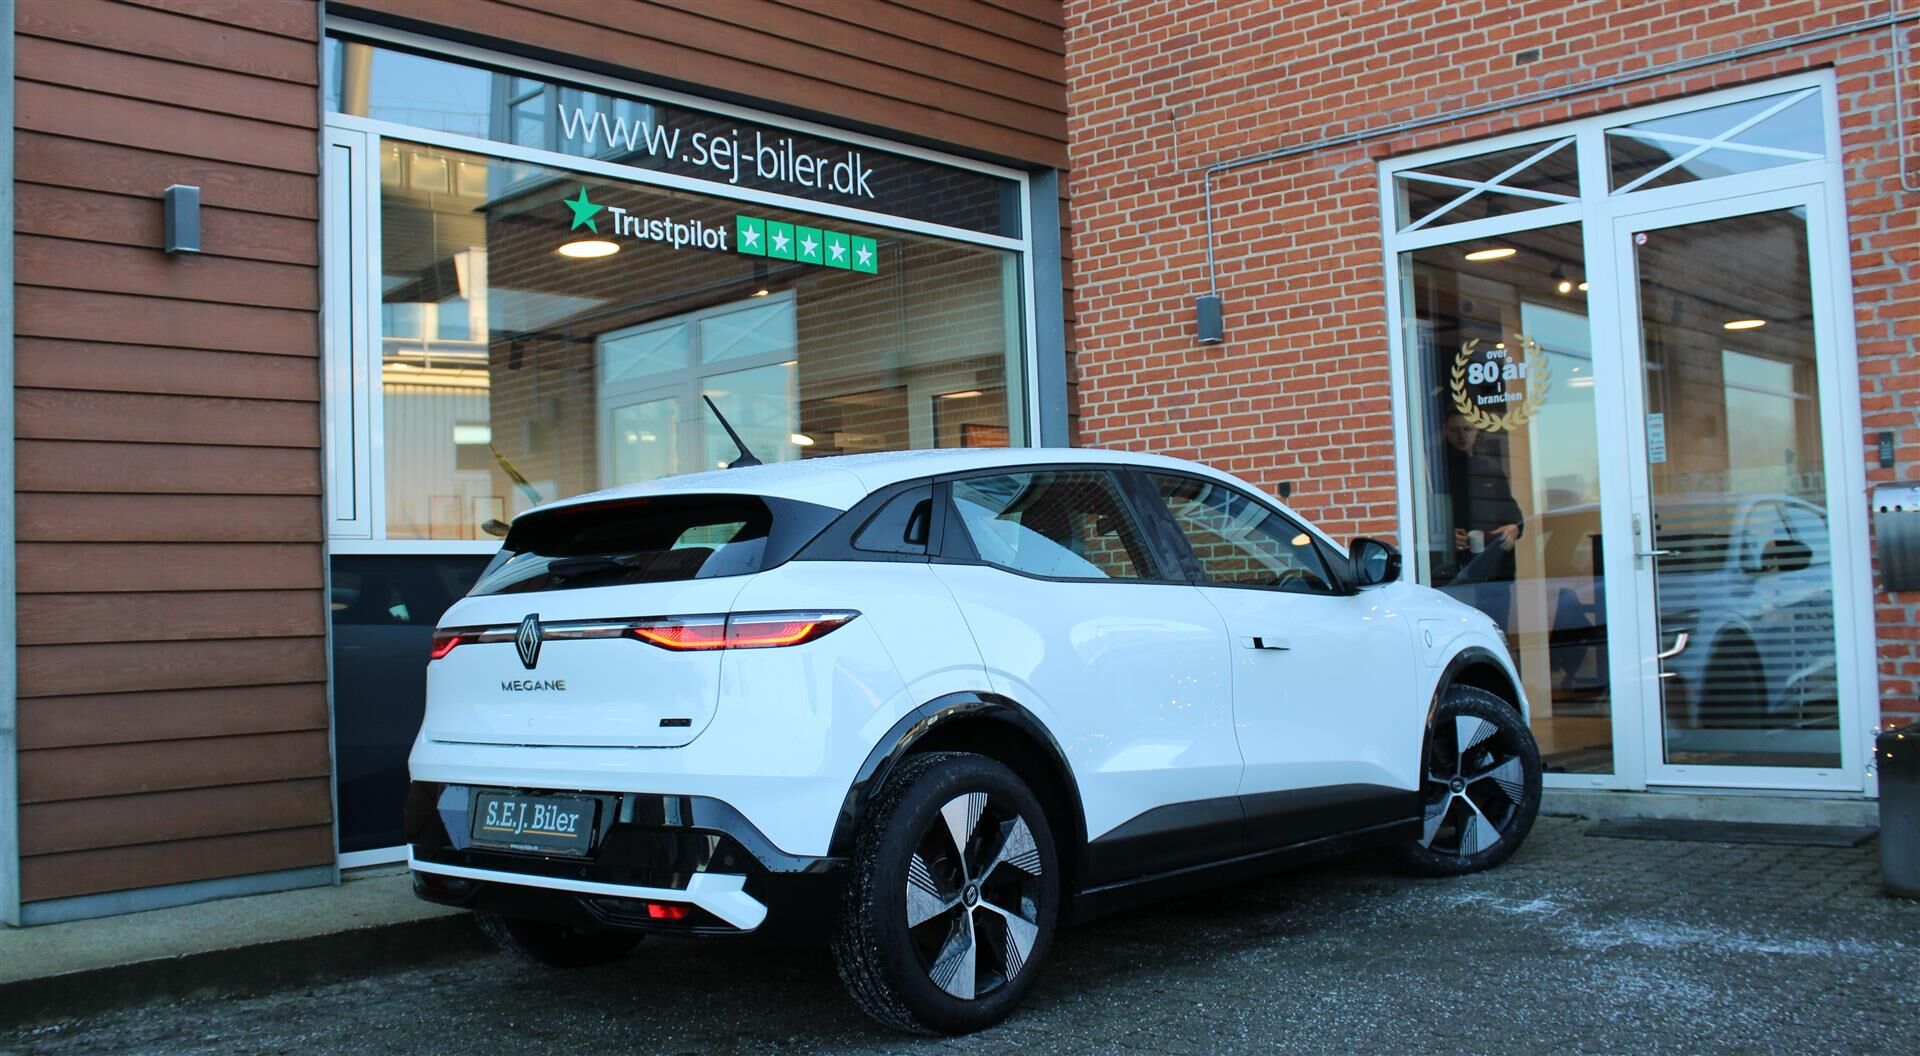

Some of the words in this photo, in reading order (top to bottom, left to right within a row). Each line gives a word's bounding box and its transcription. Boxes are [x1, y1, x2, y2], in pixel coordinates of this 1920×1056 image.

[558, 103, 875, 199] www.sej-biler.dk
[608, 206, 728, 250] Trustpilot
[1486, 349, 1508, 360] over
[1468, 361, 1499, 385] 80
[1502, 356, 1528, 380] år
[1477, 391, 1523, 405] branchen
[1497, 382, 1502, 393] i
[501, 679, 567, 692] MEGANE
[485, 800, 528, 835] S.E.J.
[531, 804, 579, 833] Biler
